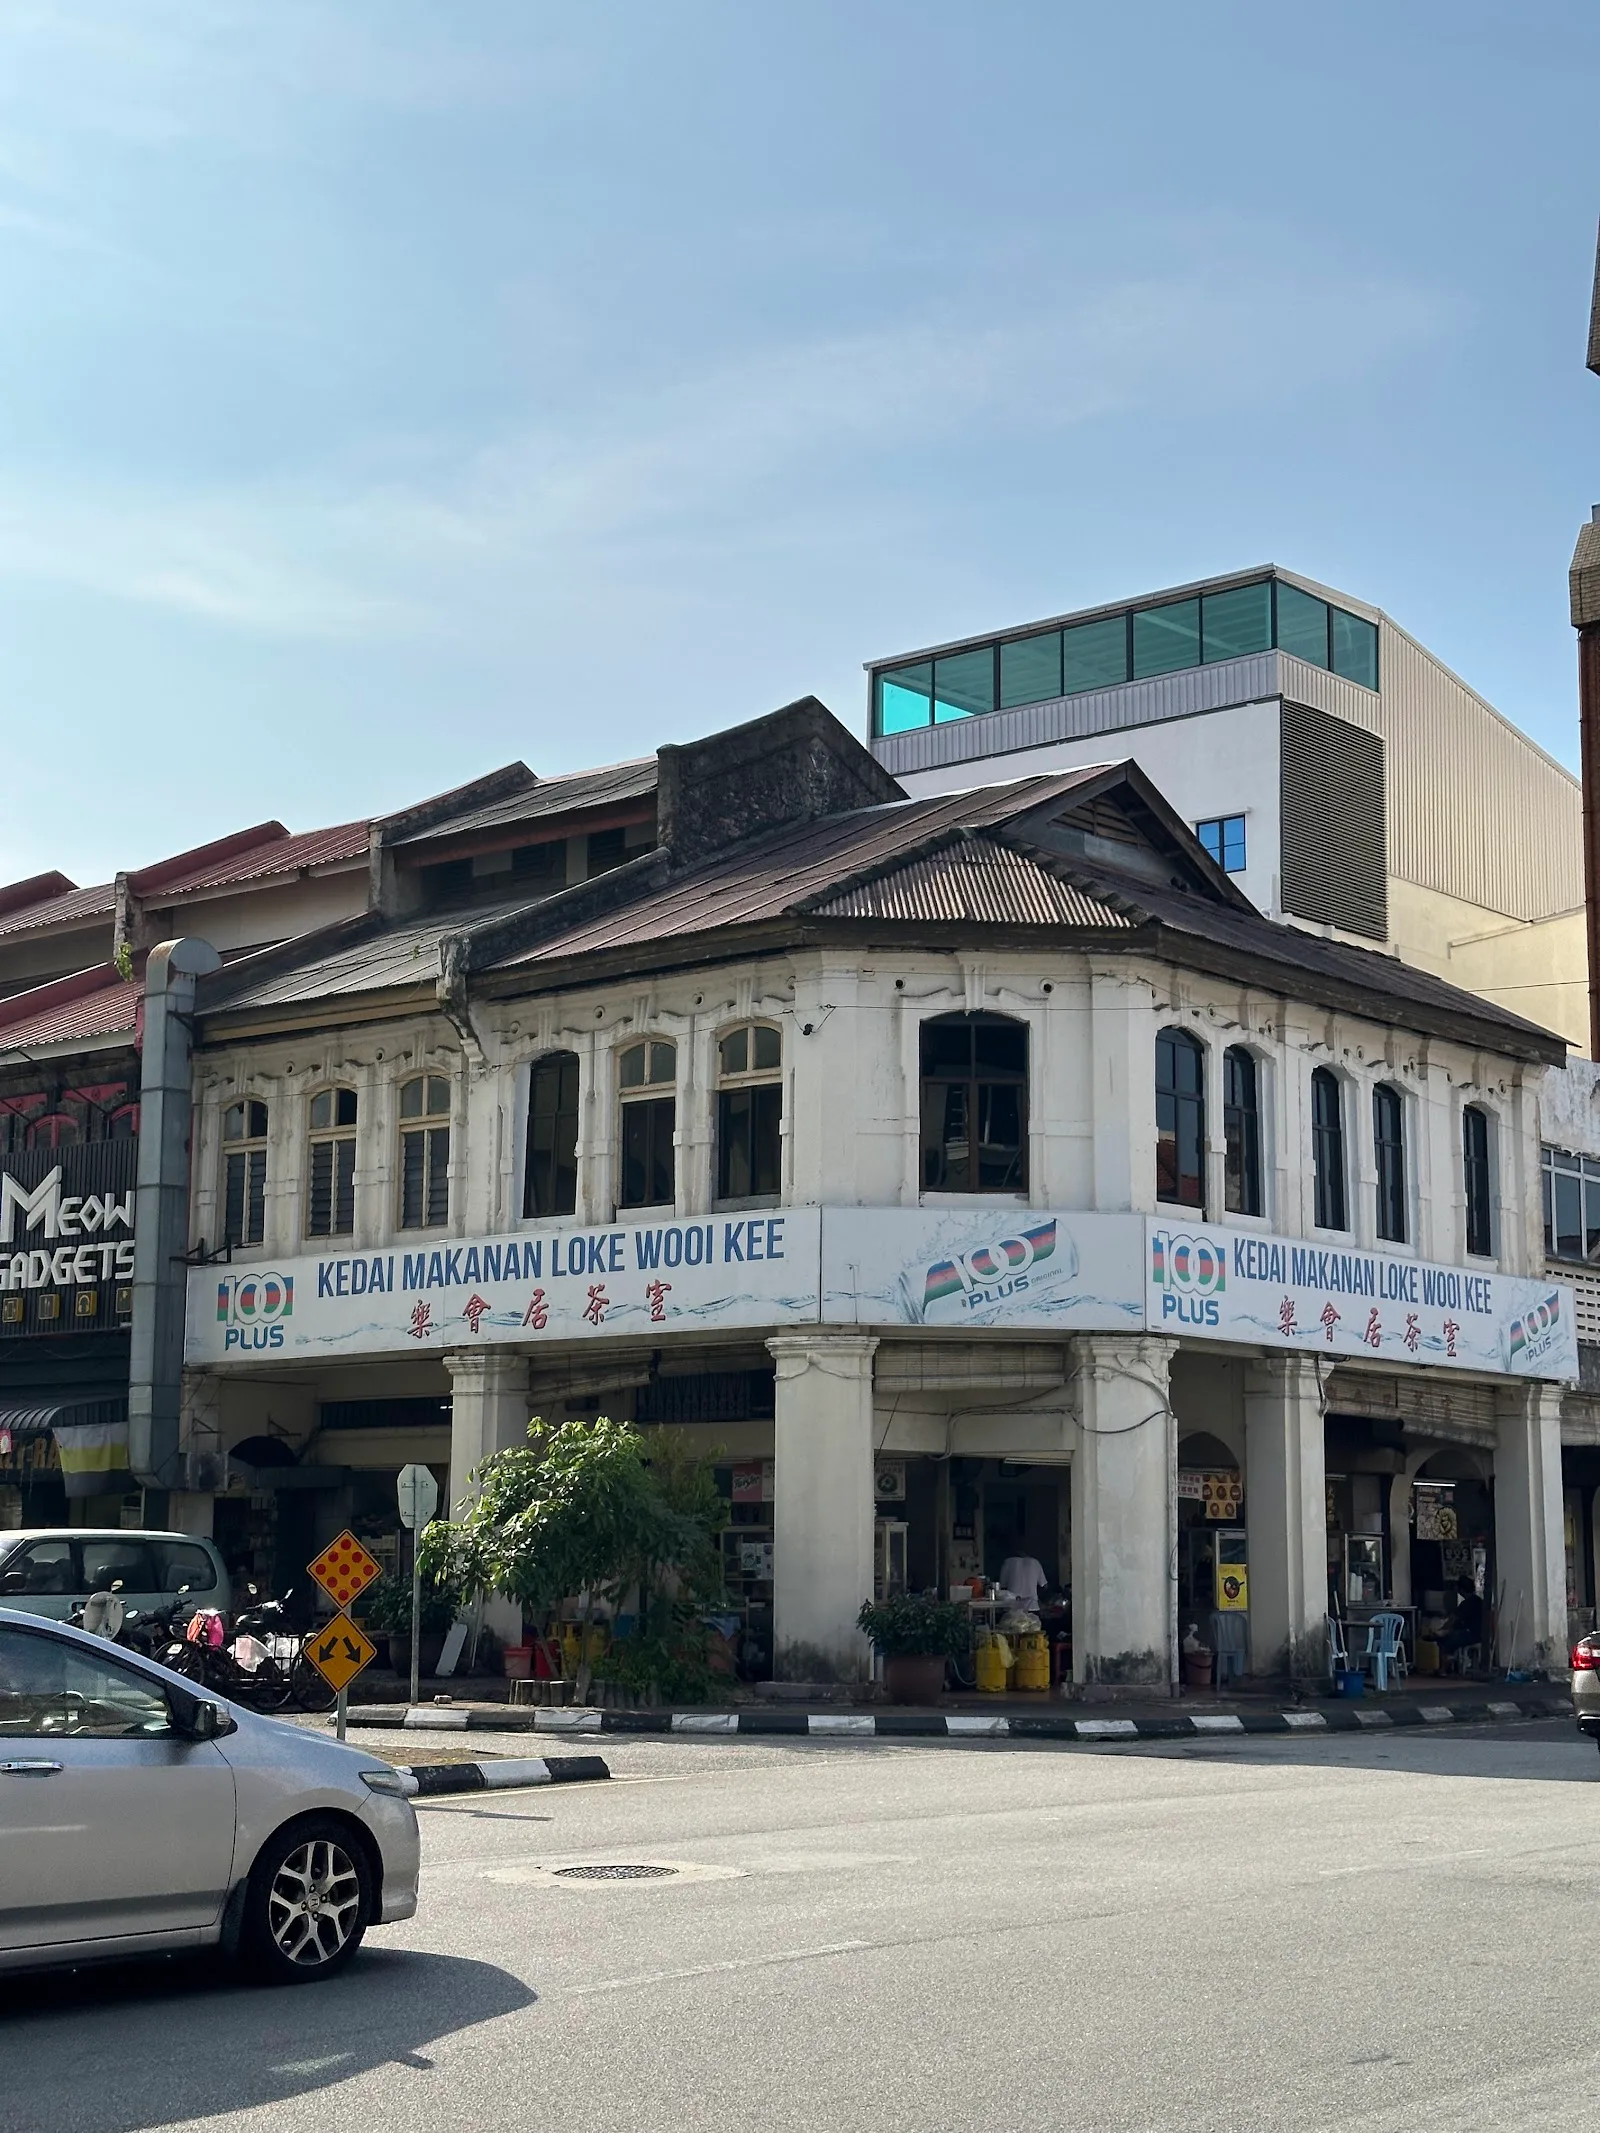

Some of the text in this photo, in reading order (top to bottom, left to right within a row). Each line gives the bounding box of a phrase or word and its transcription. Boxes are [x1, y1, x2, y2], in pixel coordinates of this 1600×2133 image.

[0, 1165, 135, 1243] MEOW
[318, 1218, 785, 1298] KEDAI MAKANAN LOKE WOOI KEE
[950, 1234, 1035, 1294] 100
[1157, 1230, 1219, 1296] 100
[1233, 1237, 1493, 1315] KEDAI MAKANAN LOKE WOOI KEE
[224, 1271, 287, 1327] 100
[968, 1275, 1030, 1310] PLUS
[1163, 1294, 1220, 1325] PLUS
[225, 1325, 284, 1351] PLUS
[1521, 1301, 1552, 1348] 100
[1528, 1336, 1552, 1362] PLUS
